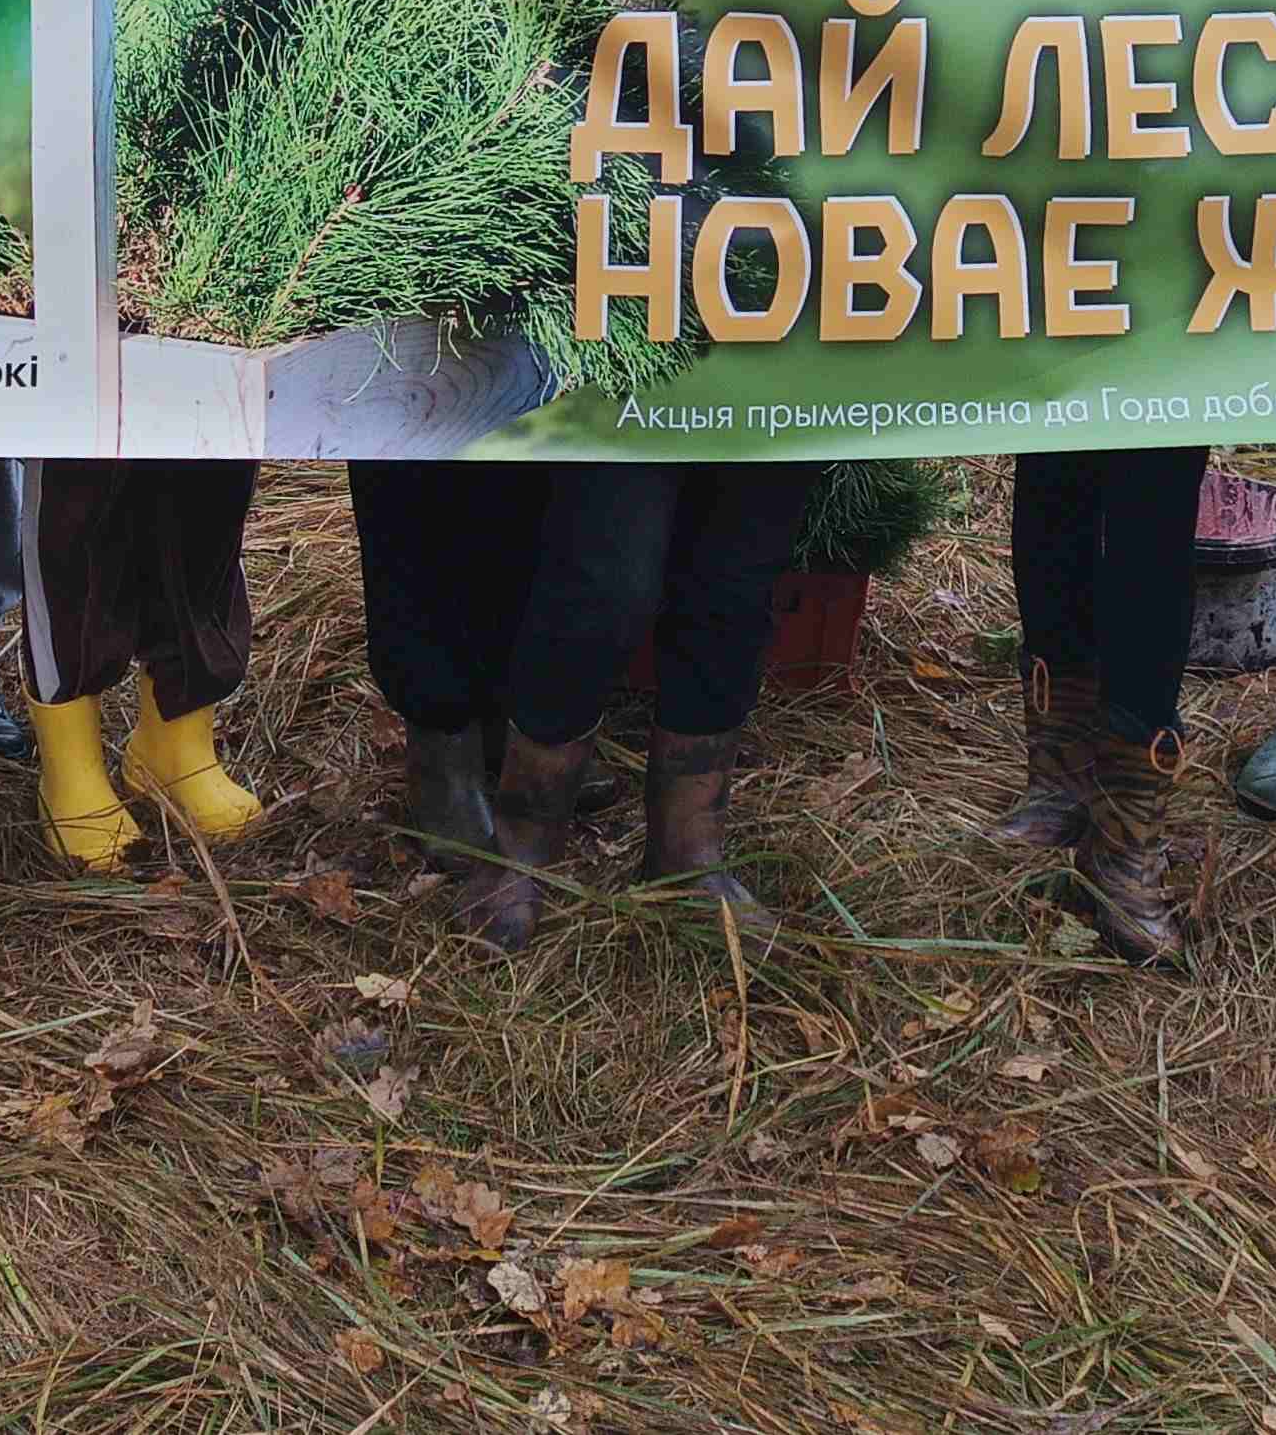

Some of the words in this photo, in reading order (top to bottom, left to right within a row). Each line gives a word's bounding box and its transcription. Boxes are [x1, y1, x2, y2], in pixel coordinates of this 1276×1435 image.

[575, 195, 1136, 342] НОВАЕ
[617, 397, 733, 434] Акцыя
[746, 399, 1030, 437] прымеркавана
[1045, 400, 1088, 426] да
[1101, 389, 1191, 425] Года
